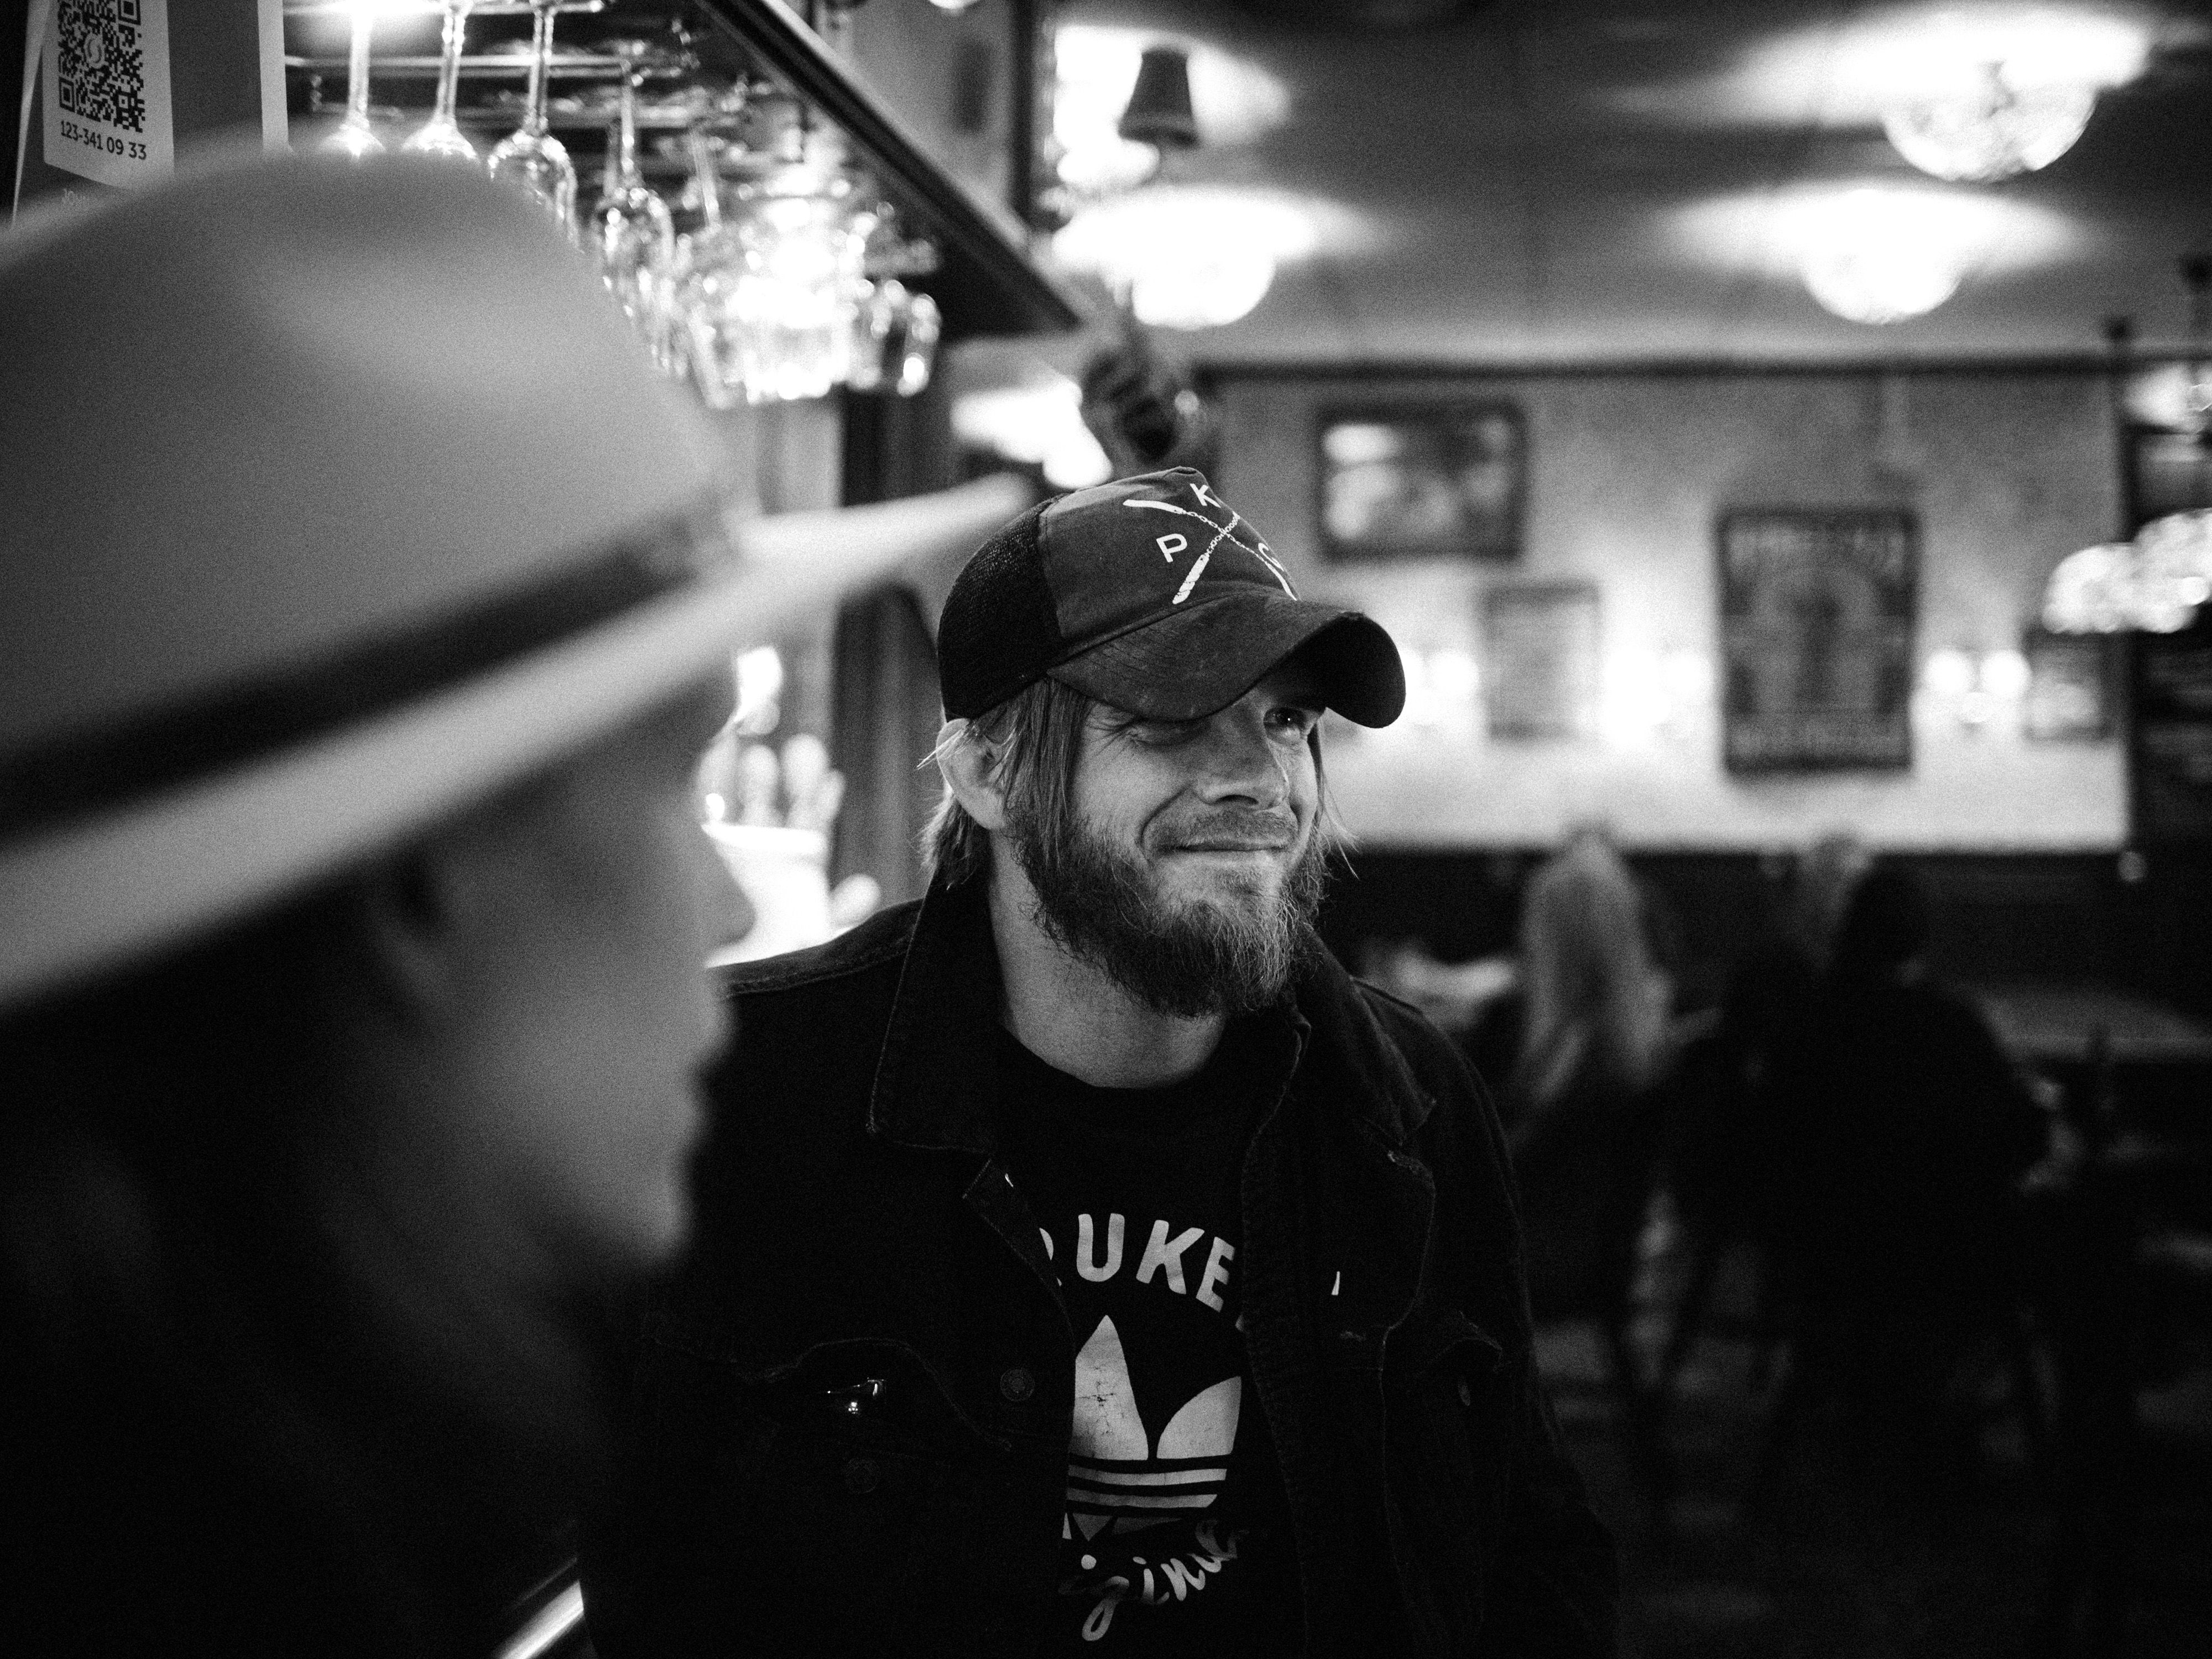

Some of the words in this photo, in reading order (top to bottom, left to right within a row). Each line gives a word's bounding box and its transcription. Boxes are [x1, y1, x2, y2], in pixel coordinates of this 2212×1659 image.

[61, 120, 103, 150] 123-341
[106, 136, 124, 155] 09
[128, 141, 147, 160] 33
[1190, 483, 1221, 508] K
[1156, 533, 1188, 562] P
[1039, 1213, 1244, 1332] UKE
